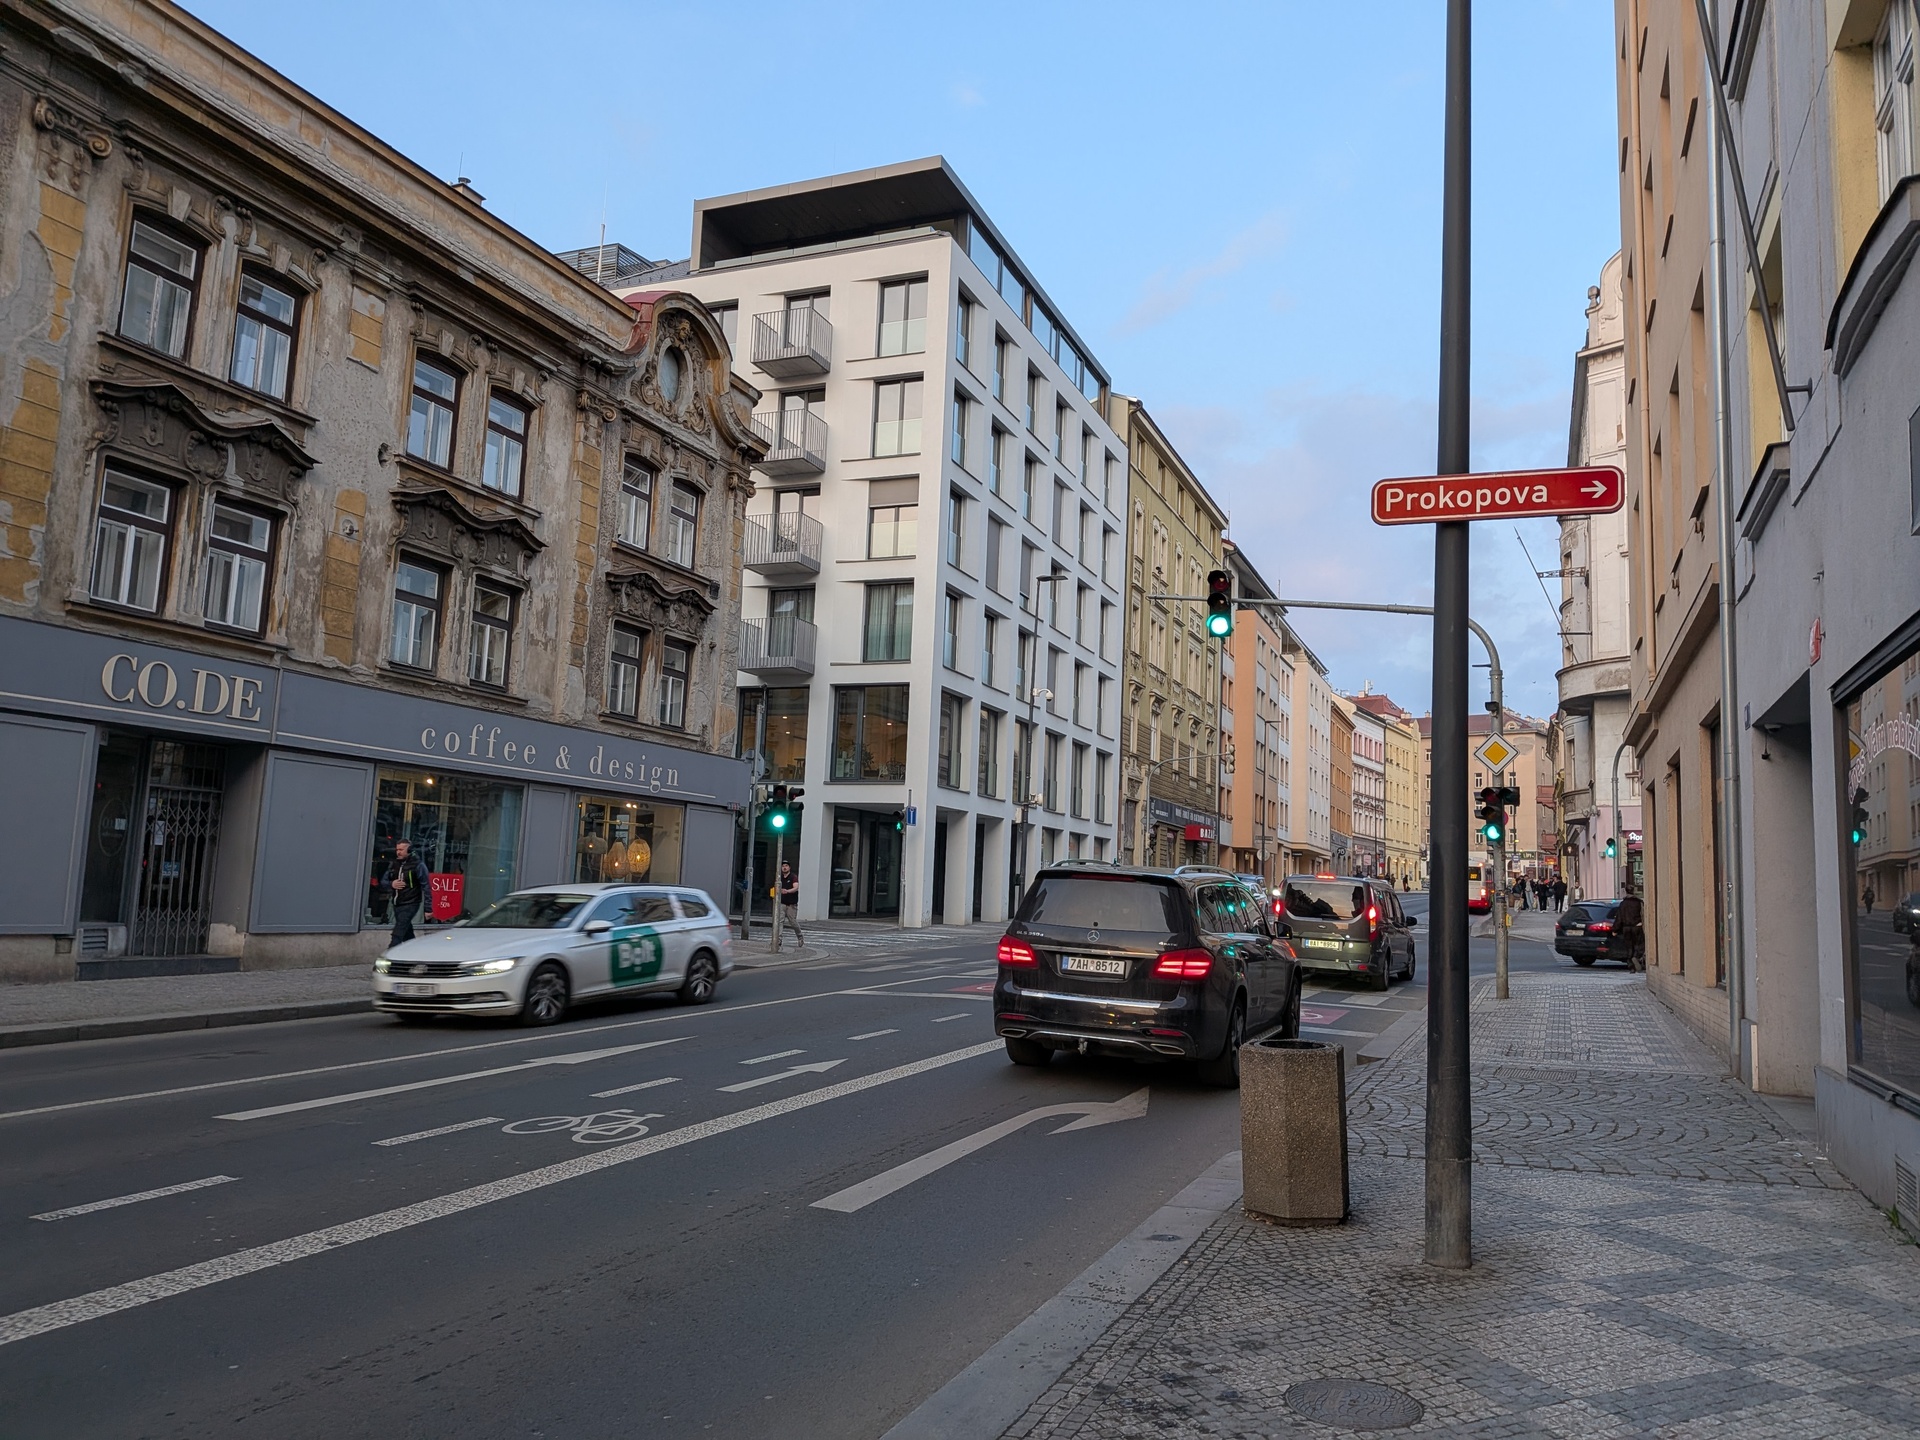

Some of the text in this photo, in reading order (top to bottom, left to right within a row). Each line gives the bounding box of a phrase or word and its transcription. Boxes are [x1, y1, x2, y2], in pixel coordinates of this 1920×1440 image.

[1385, 484, 1548, 513] Prokopova
[102, 654, 263, 722] CO.DE
[421, 723, 679, 794] coffee & design
[431, 877, 460, 892] SALE
[618, 939, 656, 969] Bolt
[1070, 957, 1120, 973] 7AH 8512
